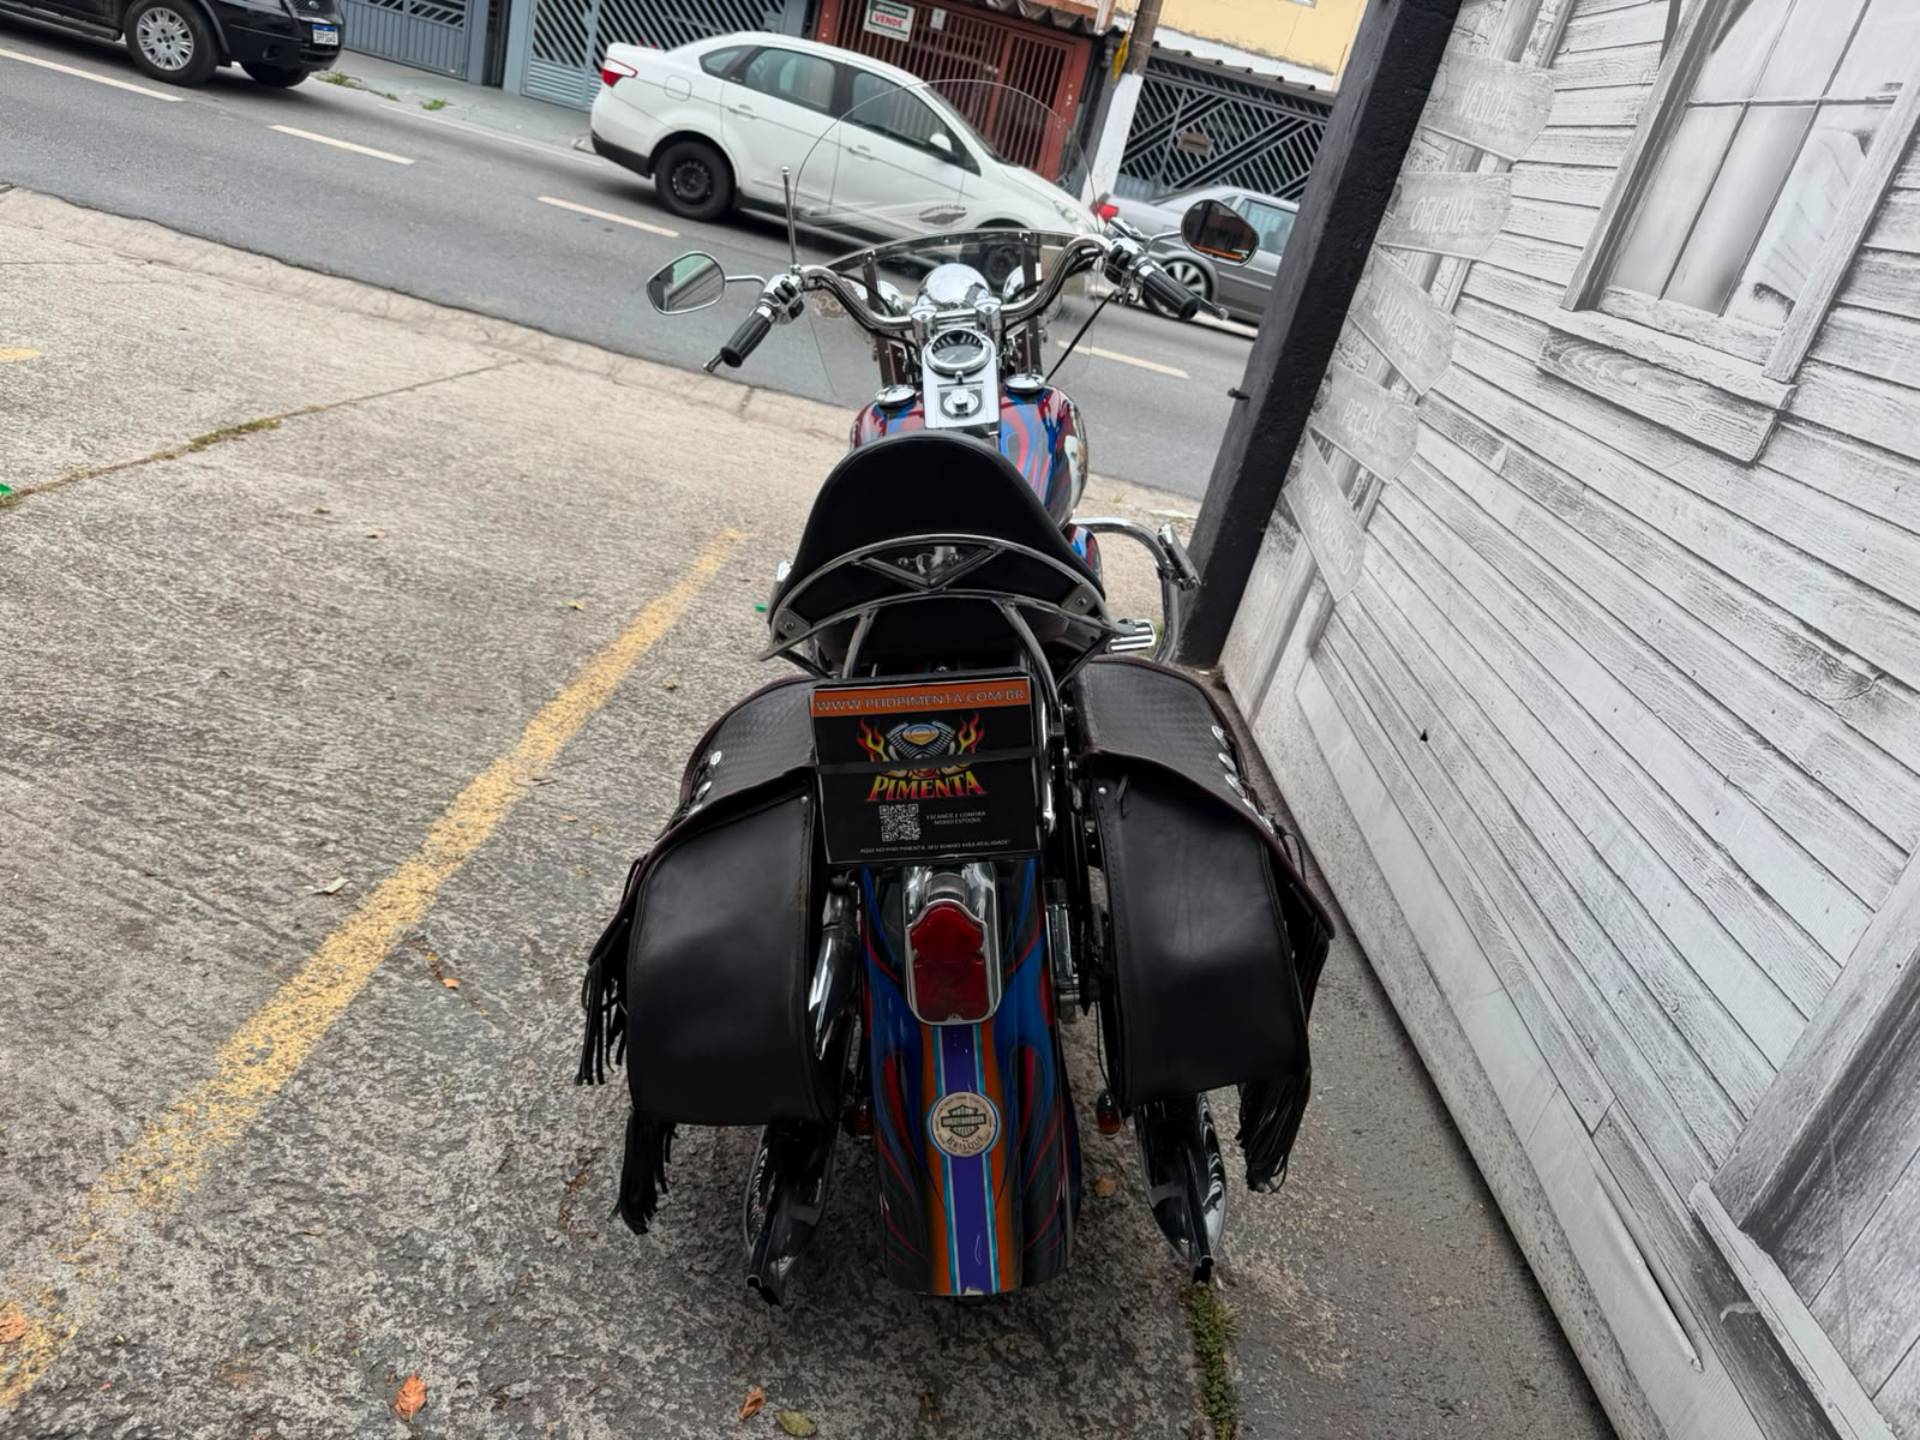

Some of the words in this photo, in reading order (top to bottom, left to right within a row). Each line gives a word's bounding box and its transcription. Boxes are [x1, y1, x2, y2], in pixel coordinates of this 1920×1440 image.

[1459, 78, 1513, 129] VENDA
[1409, 195, 1475, 235] OFICINA
[1372, 285, 1431, 361] LAVAGEM
[864, 770, 990, 802] PIMENTA
